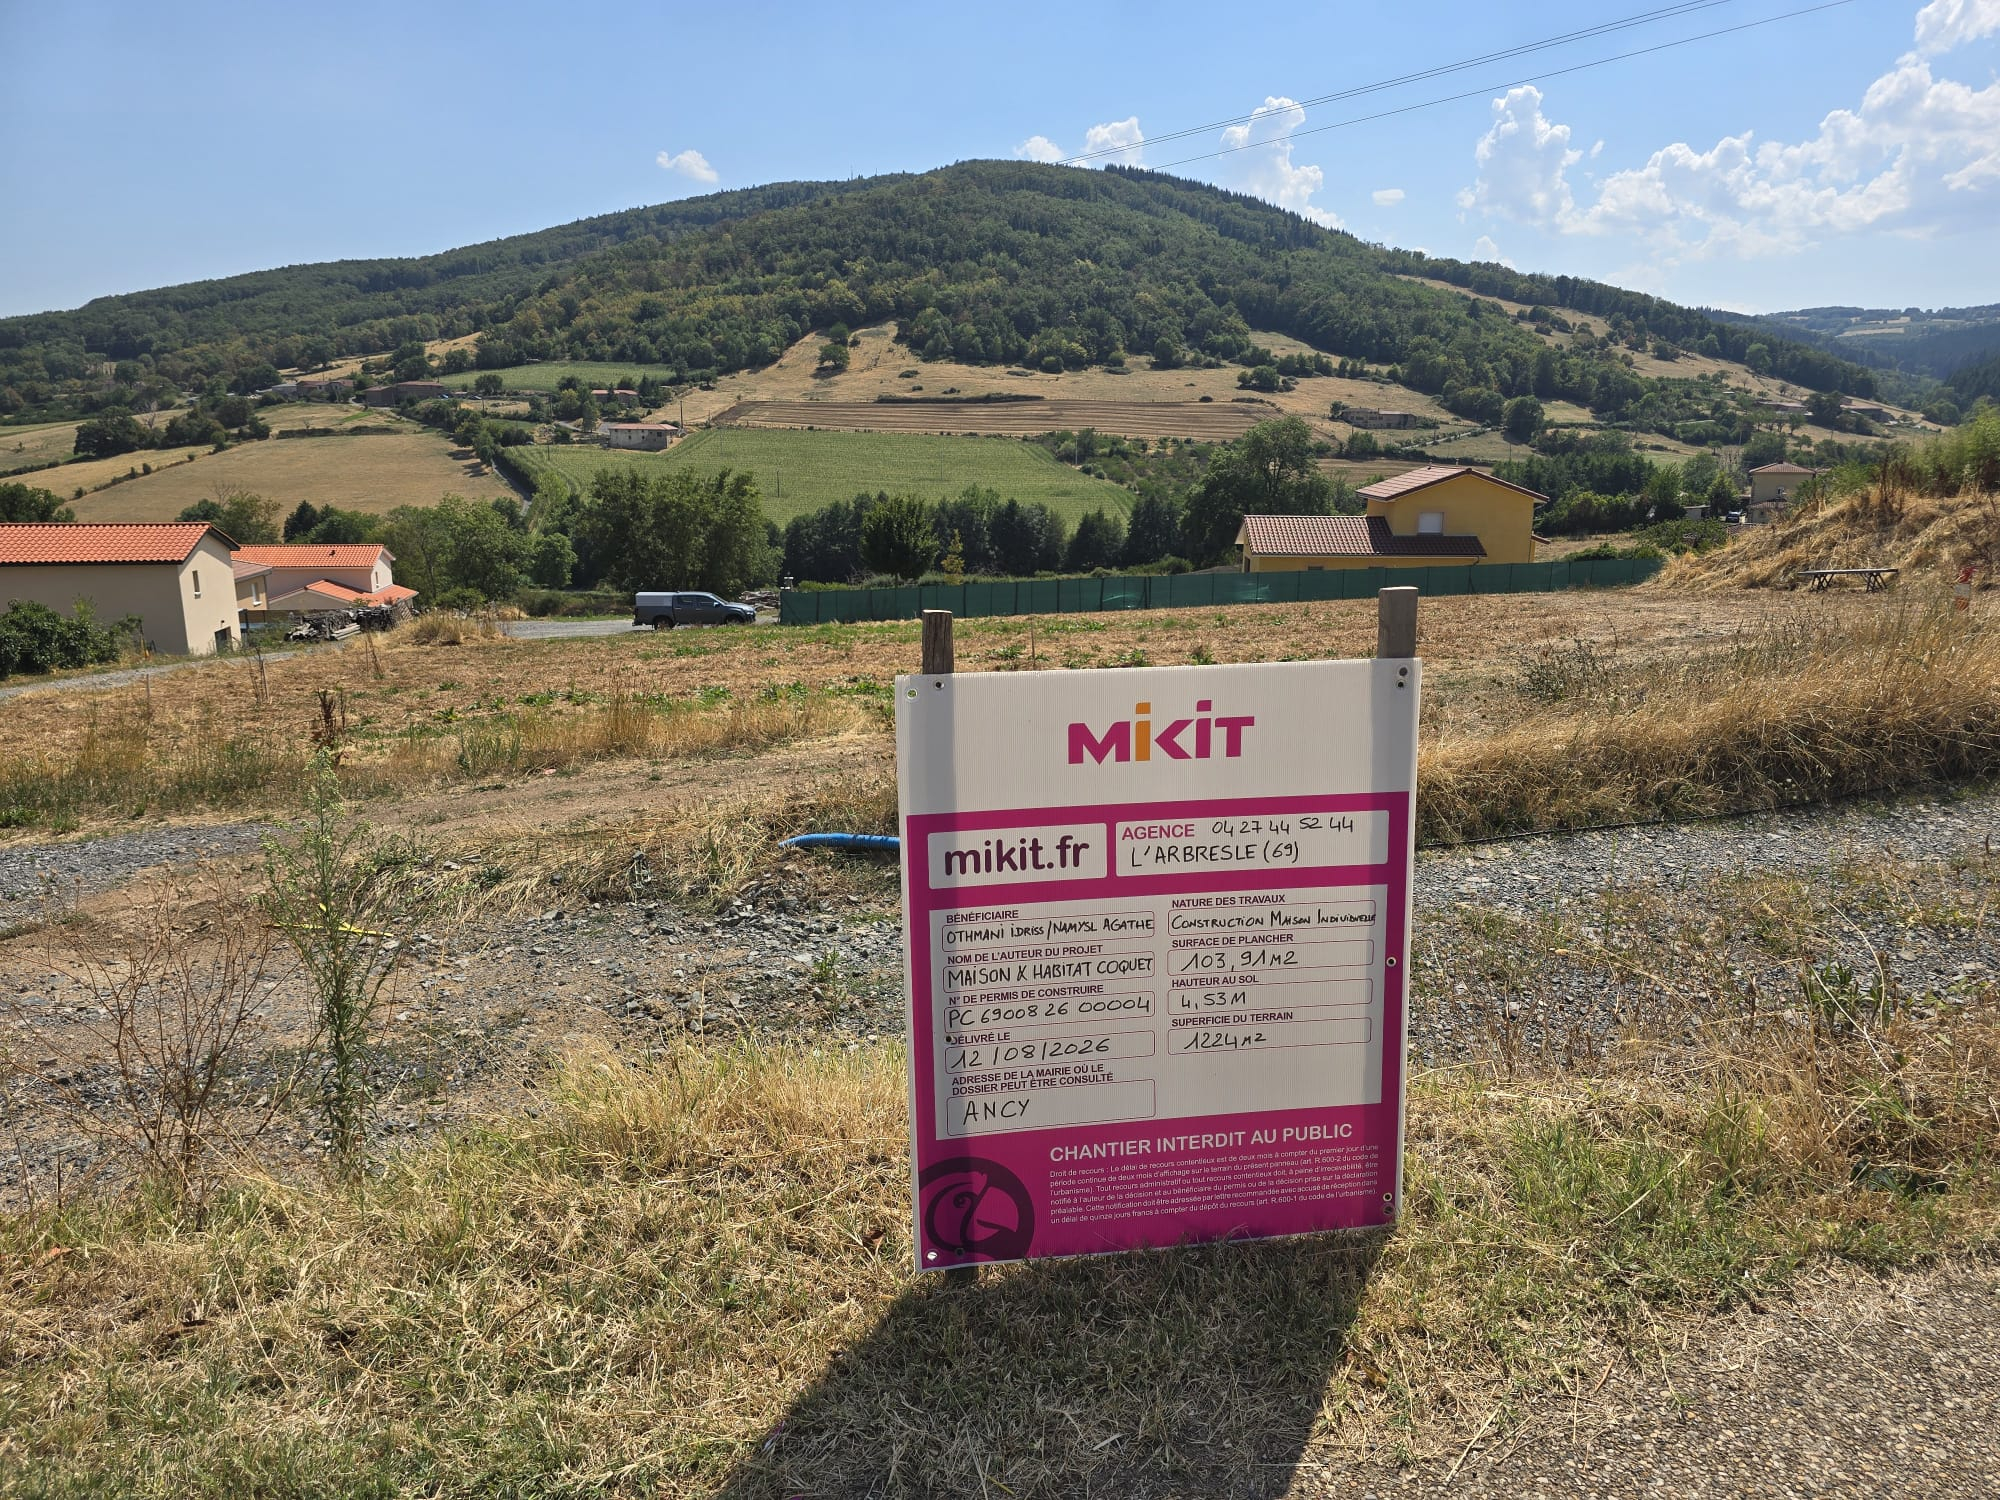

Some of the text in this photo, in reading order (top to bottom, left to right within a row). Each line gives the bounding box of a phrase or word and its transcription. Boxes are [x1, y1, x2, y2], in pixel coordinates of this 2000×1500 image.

[1121, 823, 1195, 841] AGENCE
[1211, 815, 1353, 838] 04 27 44 52 44
[944, 834, 1090, 876] mikit.fr
[1263, 839, 1299, 864] (69)
[1172, 894, 1286, 909] NATURE DES TRAVAUX
[946, 909, 1019, 923] BÉNÉFICIAIRE
[1102, 917, 1154, 932] AGATHE
[1171, 933, 1294, 950] SURFACE DE PLANCHER
[947, 944, 1104, 965] NOM DE L'AUTEUR DU PROJET
[1033, 961, 1093, 980] HABITAT
[1096, 957, 1154, 975] COQUET
[1171, 974, 1260, 988] HAUTEUR AU SOL
[963, 994, 978, 1004] DE
[979, 991, 1019, 1003] PERMIS
[1020, 989, 1036, 999] DE
[1037, 984, 1104, 998] CONSTRUIRE
[949, 996, 1150, 1029] PC 69008 26 00004
[1171, 1011, 1293, 1028] SUPERFICIE DU TERRAIN
[997, 1031, 1011, 1042] LE
[951, 1063, 1104, 1086] ADRESSE DE LA MAIRIE OÙ LE
[952, 1071, 1114, 1096] DOSSIER PEUT ÊTRE CONSULTÉ
[963, 1098, 1030, 1125] ANCY
[1050, 1123, 1352, 1162] CHANTIER INTERDIT AU PUBLIC
